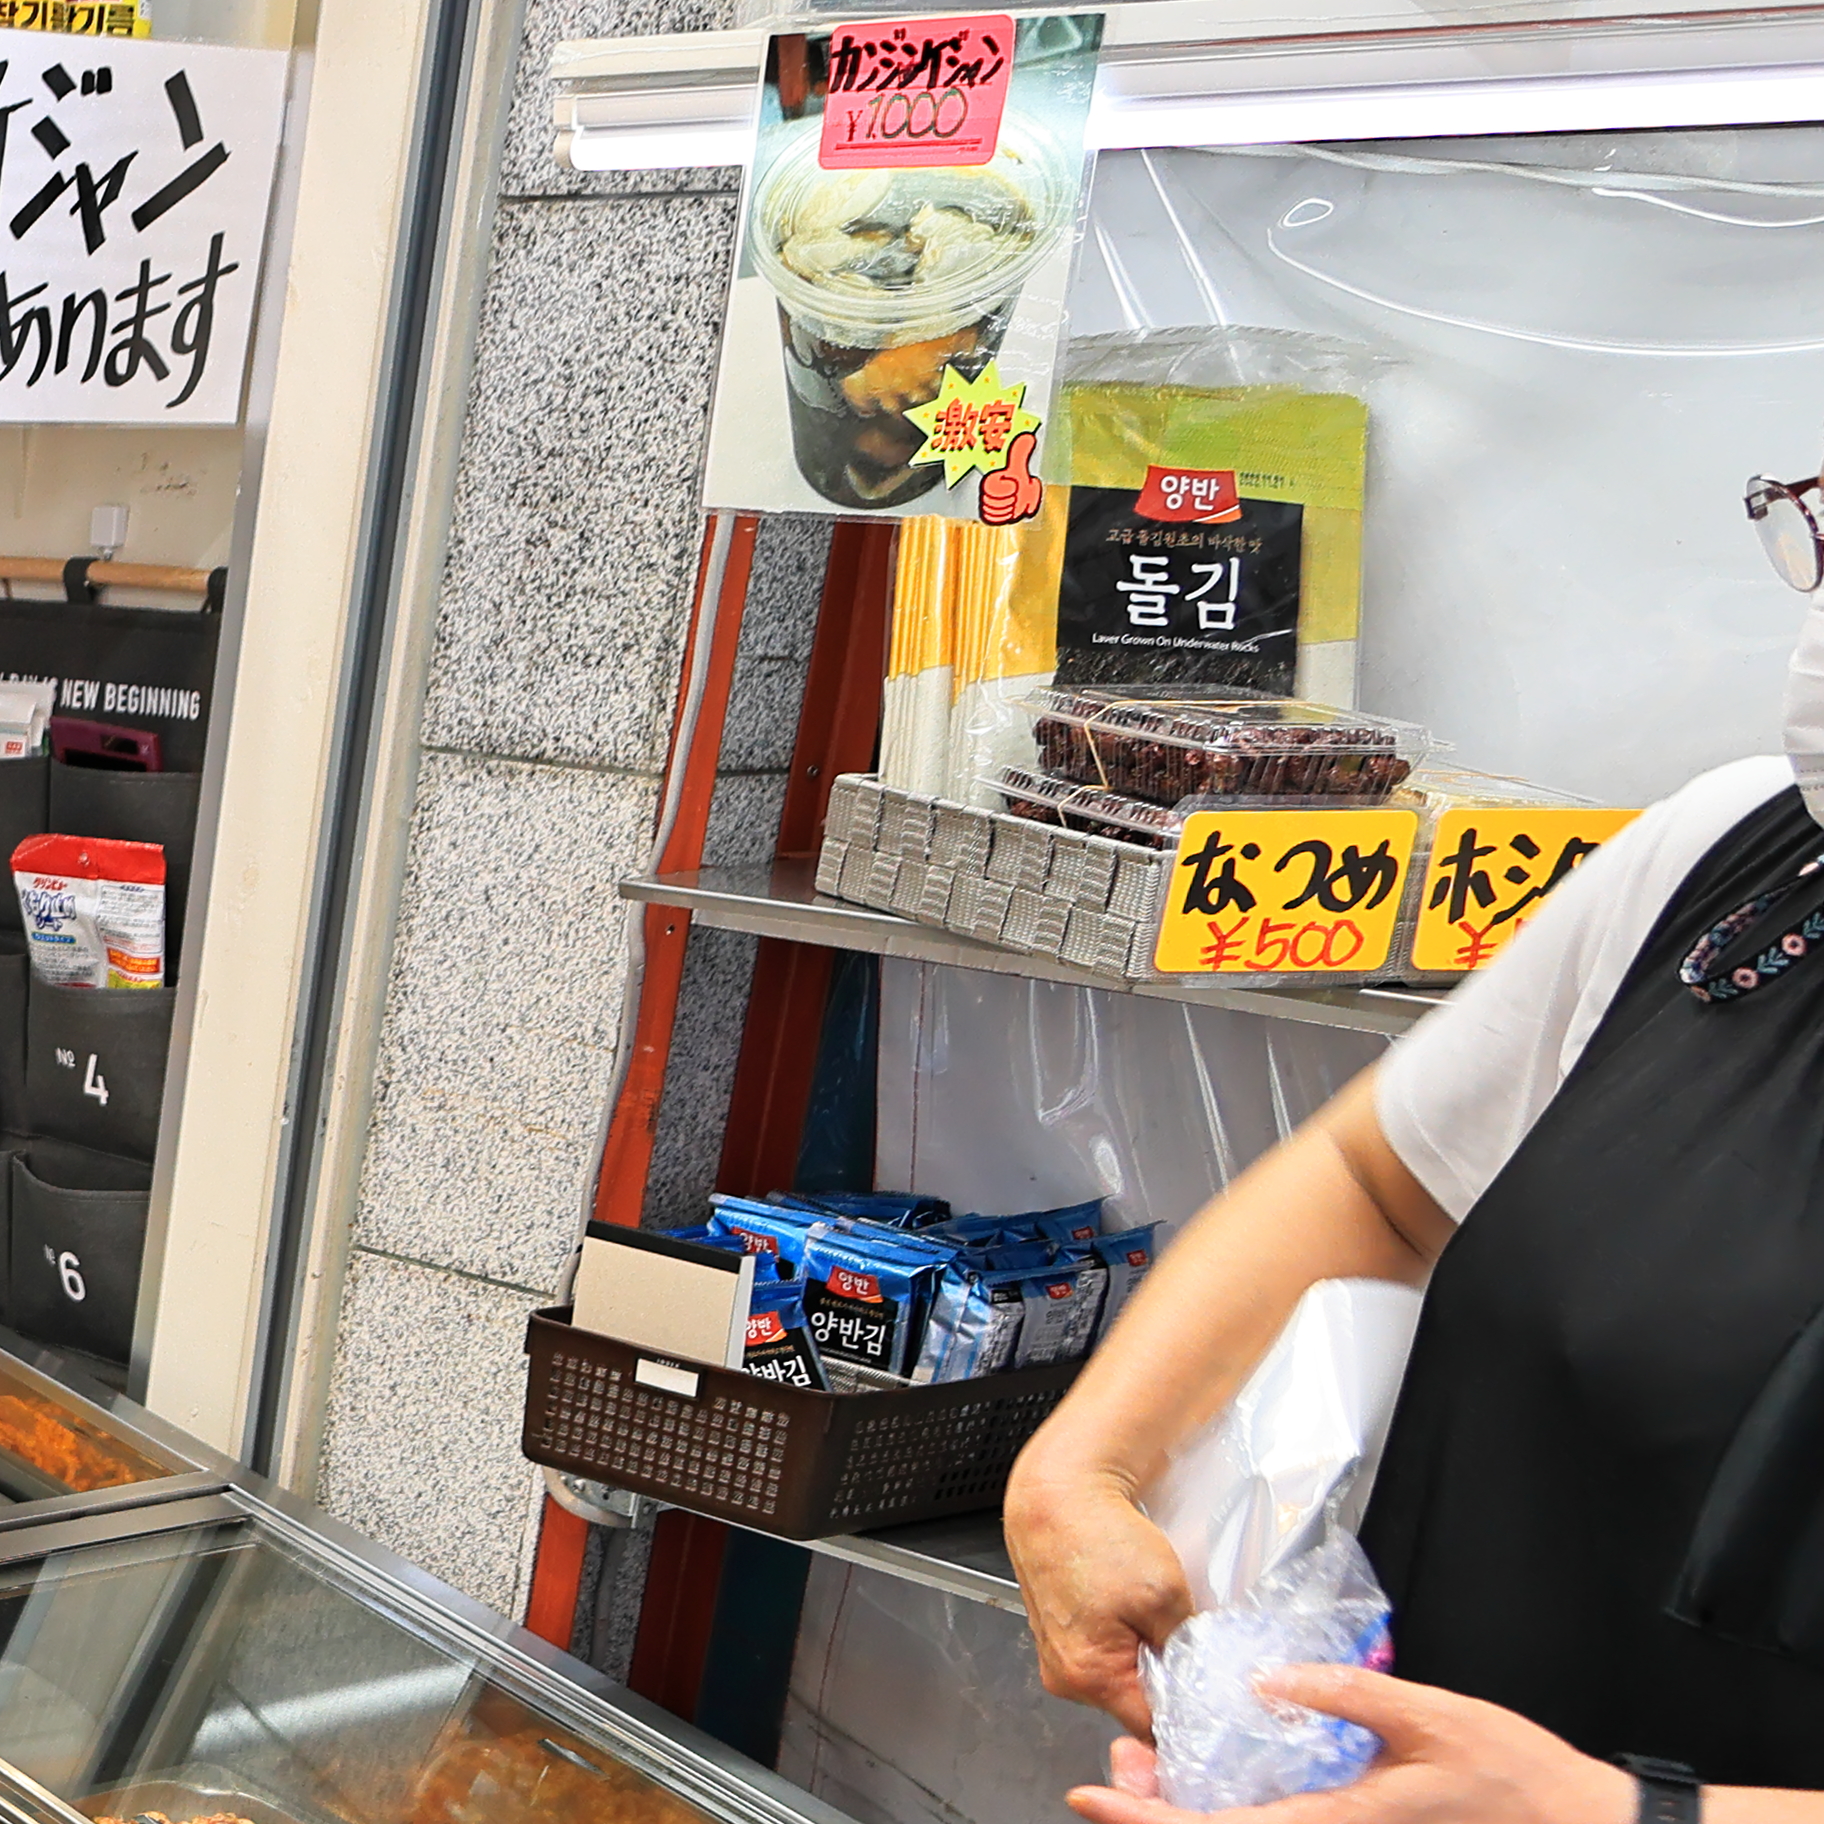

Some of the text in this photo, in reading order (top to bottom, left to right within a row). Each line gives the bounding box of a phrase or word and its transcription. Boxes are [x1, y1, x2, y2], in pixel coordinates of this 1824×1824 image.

[931, 397, 1016, 454] 激安
[1160, 475, 1220, 511] 양반
[1116, 553, 1241, 630] 돌김
[1092, 632, 1119, 645] Laver
[1120, 633, 1155, 647] Grown
[1156, 635, 1171, 646] On
[1172, 636, 1230, 651] Underwater
[60, 677, 201, 720] NEW BEGINNING
[1181, 830, 1399, 915] なつめ
[1198, 916, 1365, 972] ¥500
[83, 1053, 110, 1106] 4
[58, 1251, 86, 1302] 6
[838, 1271, 870, 1295] 양반
[810, 1310, 886, 1356] 양반김
